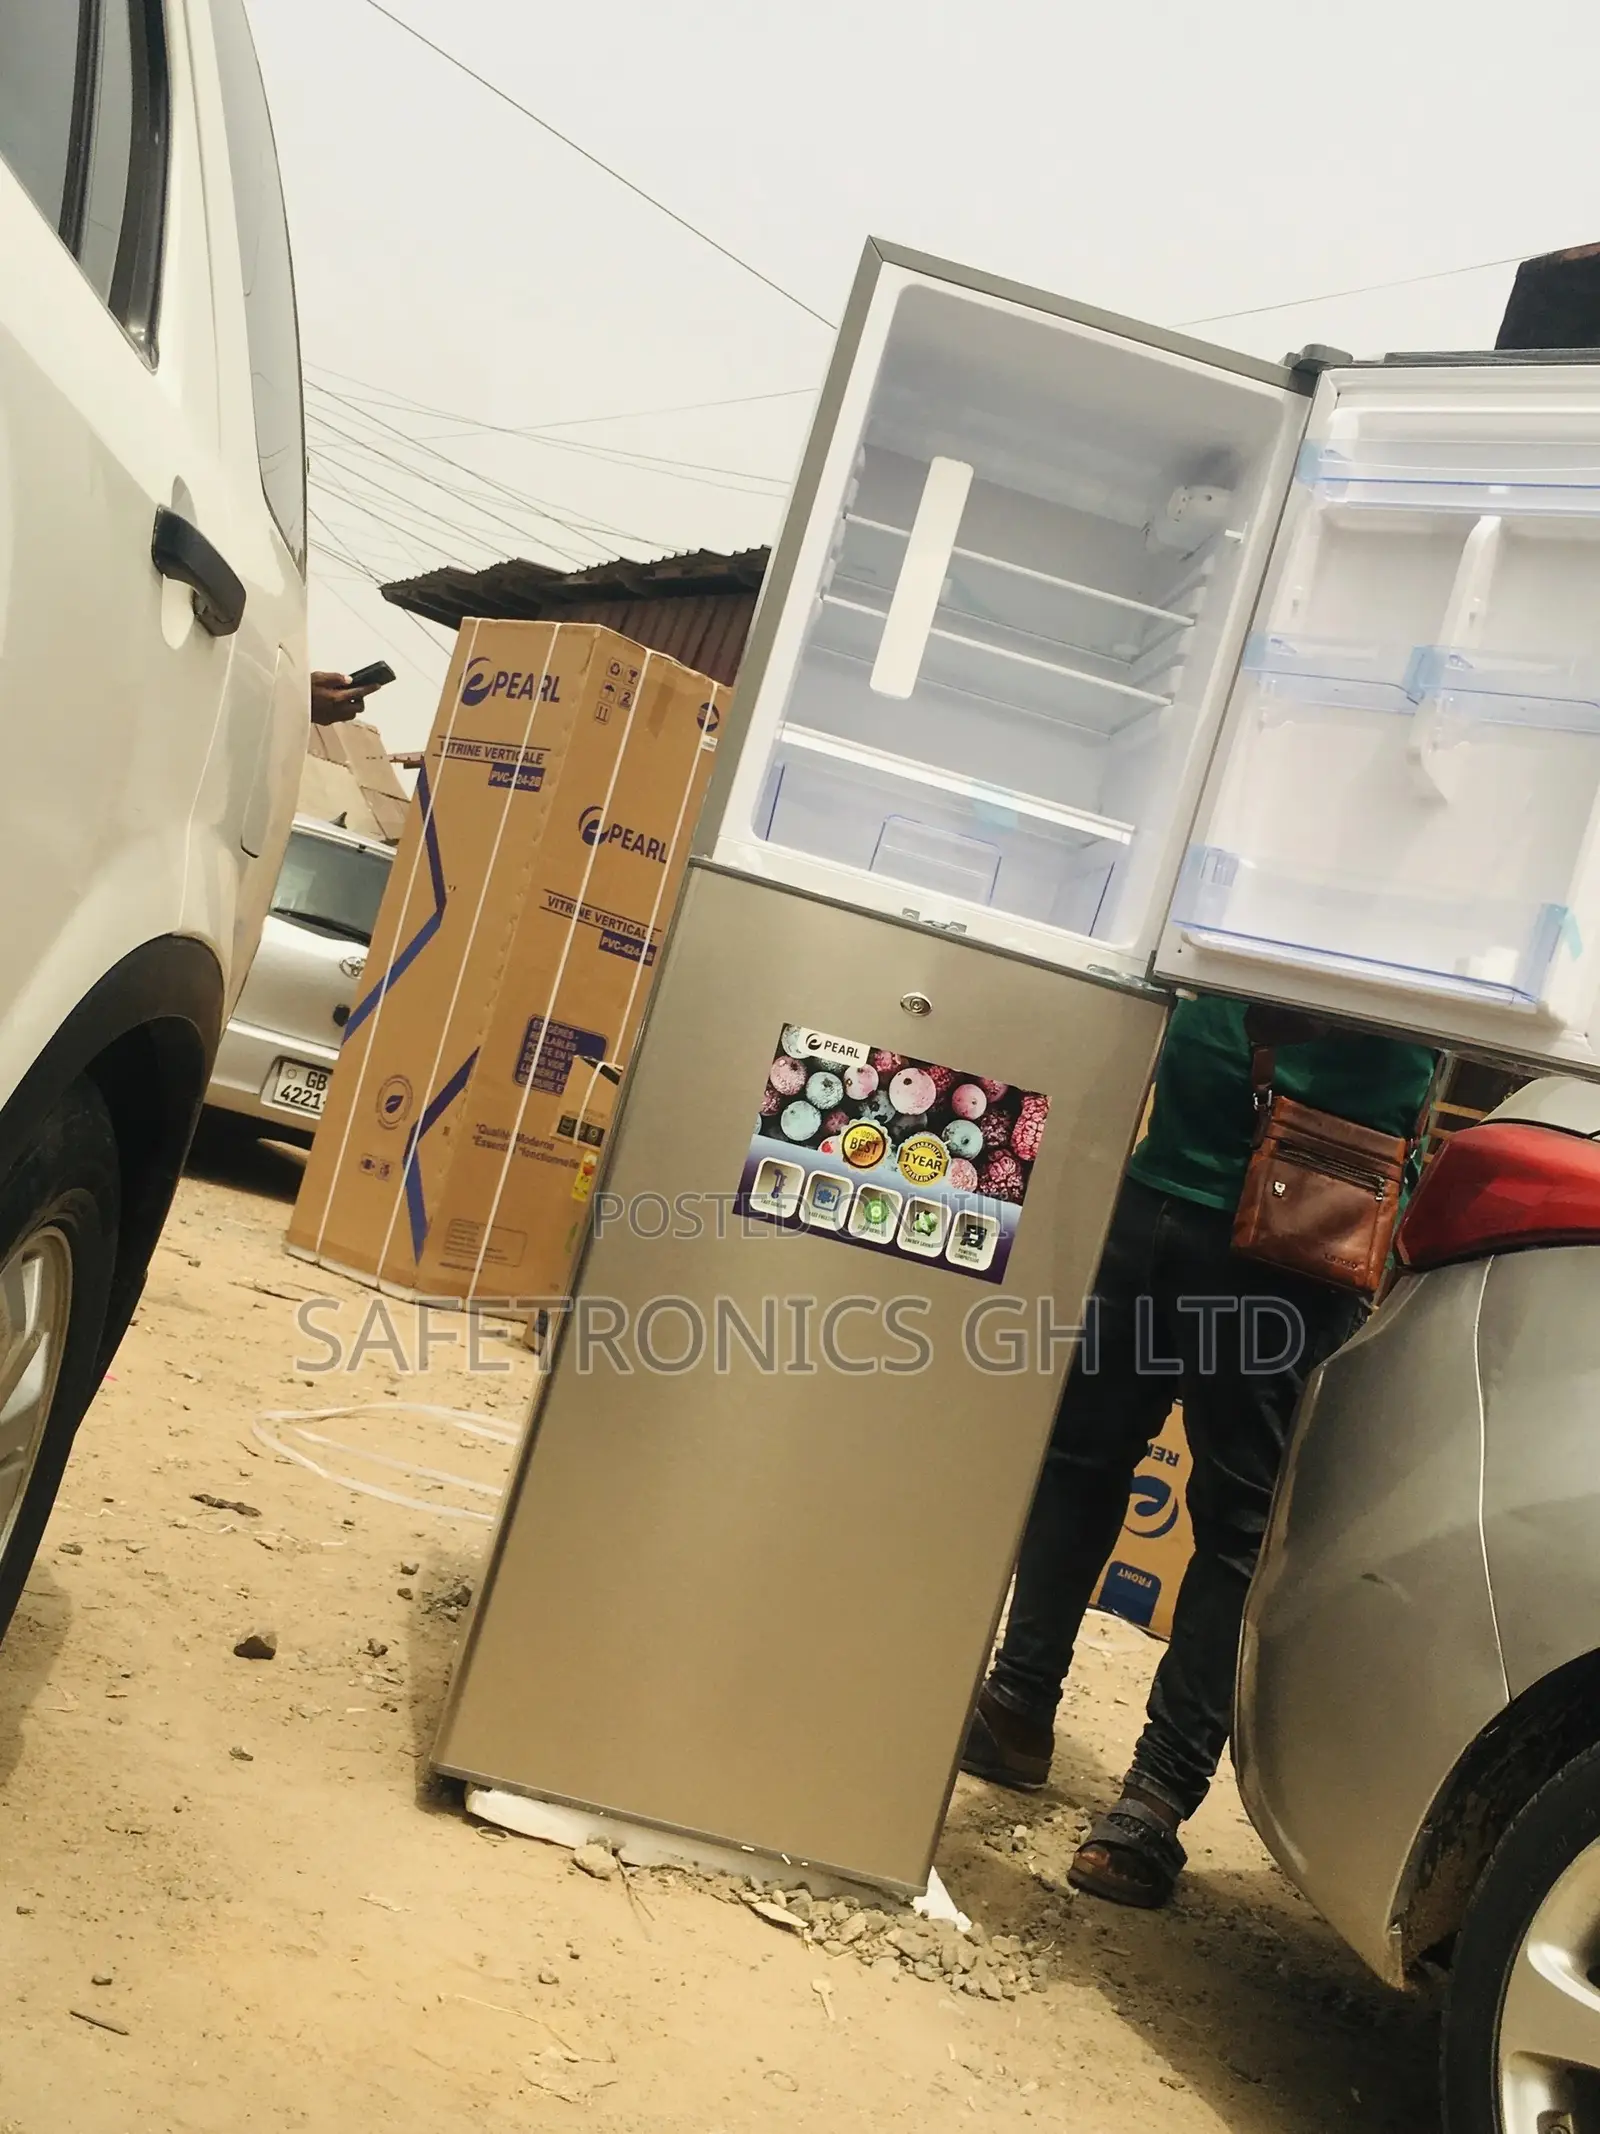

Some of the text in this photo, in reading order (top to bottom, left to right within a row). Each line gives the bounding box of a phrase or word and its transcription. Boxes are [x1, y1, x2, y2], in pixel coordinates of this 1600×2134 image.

[491, 671, 560, 703] PEARL
[608, 822, 667, 864] PEARL
[824, 1040, 860, 1059] PEARL
[305, 1071, 328, 1091] GB
[850, 1137, 879, 1155] BEST
[908, 1140, 942, 1159] WARRANTY
[904, 1152, 942, 1171] 1 YEAR
[904, 1163, 938, 1182] WARRANTY
[1116, 1567, 1152, 1588] FRONT
